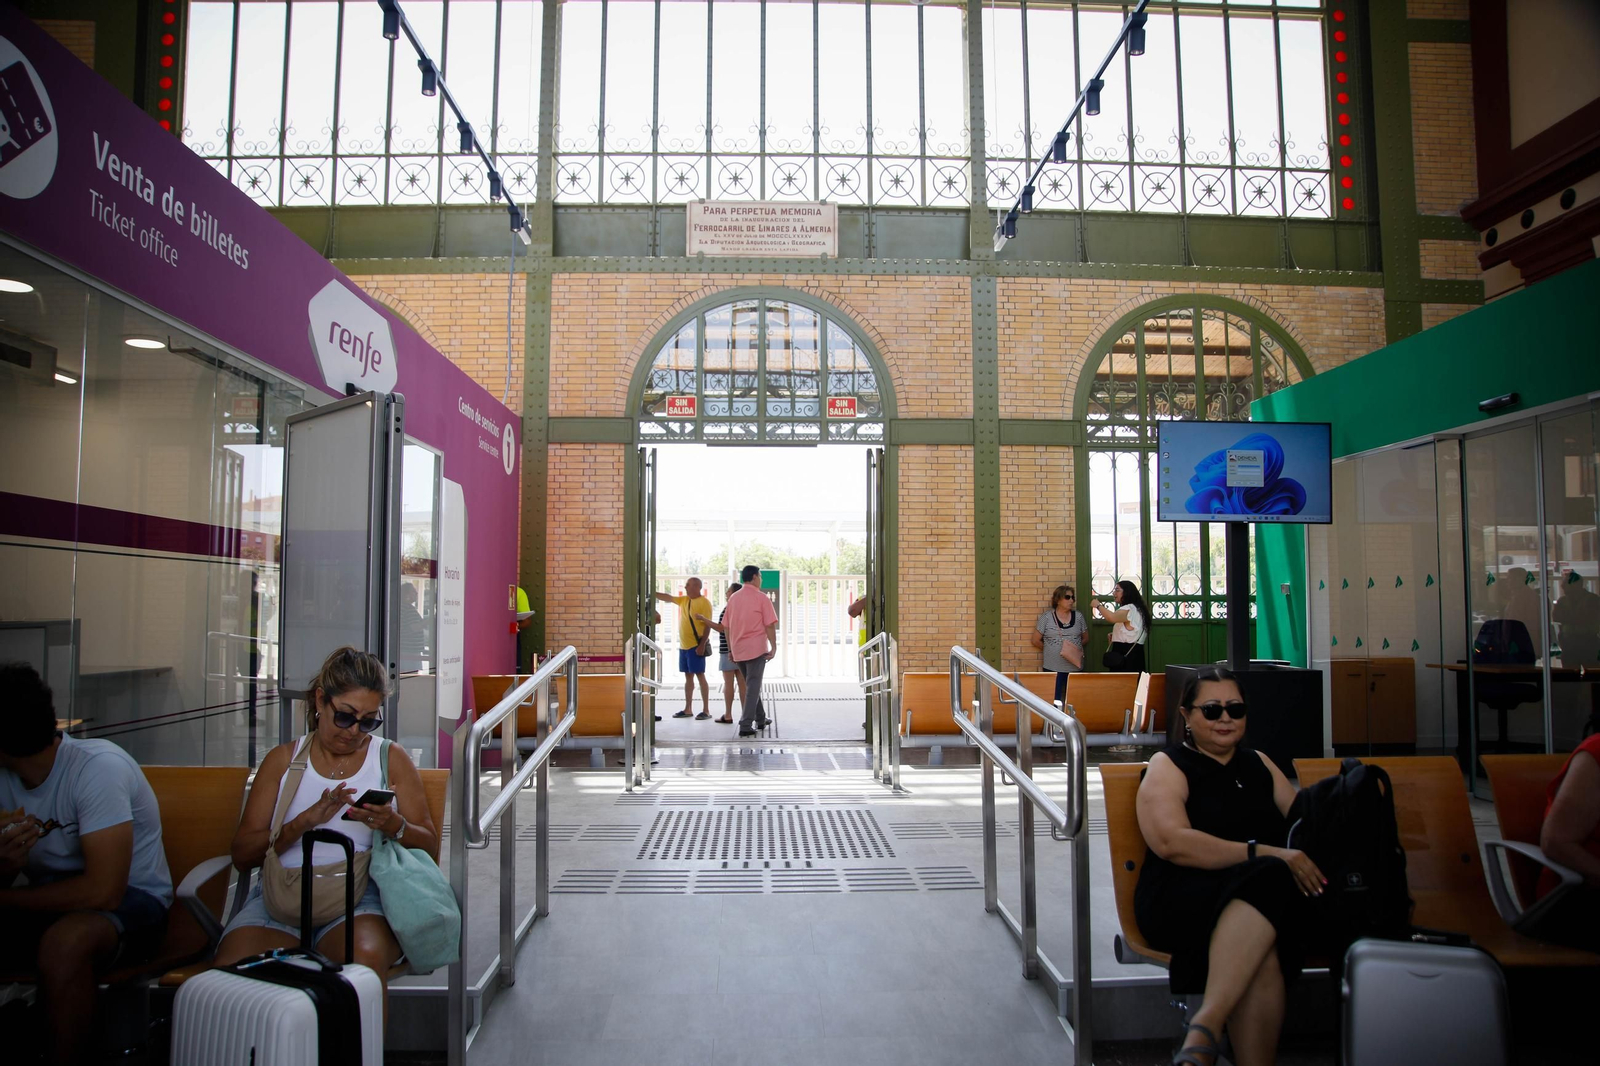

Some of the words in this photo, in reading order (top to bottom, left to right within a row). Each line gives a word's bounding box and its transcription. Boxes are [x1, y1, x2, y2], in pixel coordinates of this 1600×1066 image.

[93, 130, 155, 206] Venta
[161, 185, 184, 226] de
[190, 201, 249, 270] billetes
[703, 206, 727, 215] PARA
[730, 207, 777, 216] PERPETUA
[89, 188, 136, 242] Ticket
[140, 226, 178, 267] office
[694, 224, 744, 232] FERROCARRIL
[758, 224, 790, 232] LINARES
[800, 224, 832, 232] ALMERIA
[329, 321, 382, 378] renfe
[458, 396, 474, 420] Centro
[474, 408, 482, 426] de
[482, 416, 500, 438] servicios
[668, 406, 694, 414] SALIDA
[829, 408, 854, 416] SALIDA
[444, 566, 460, 580] Horario
